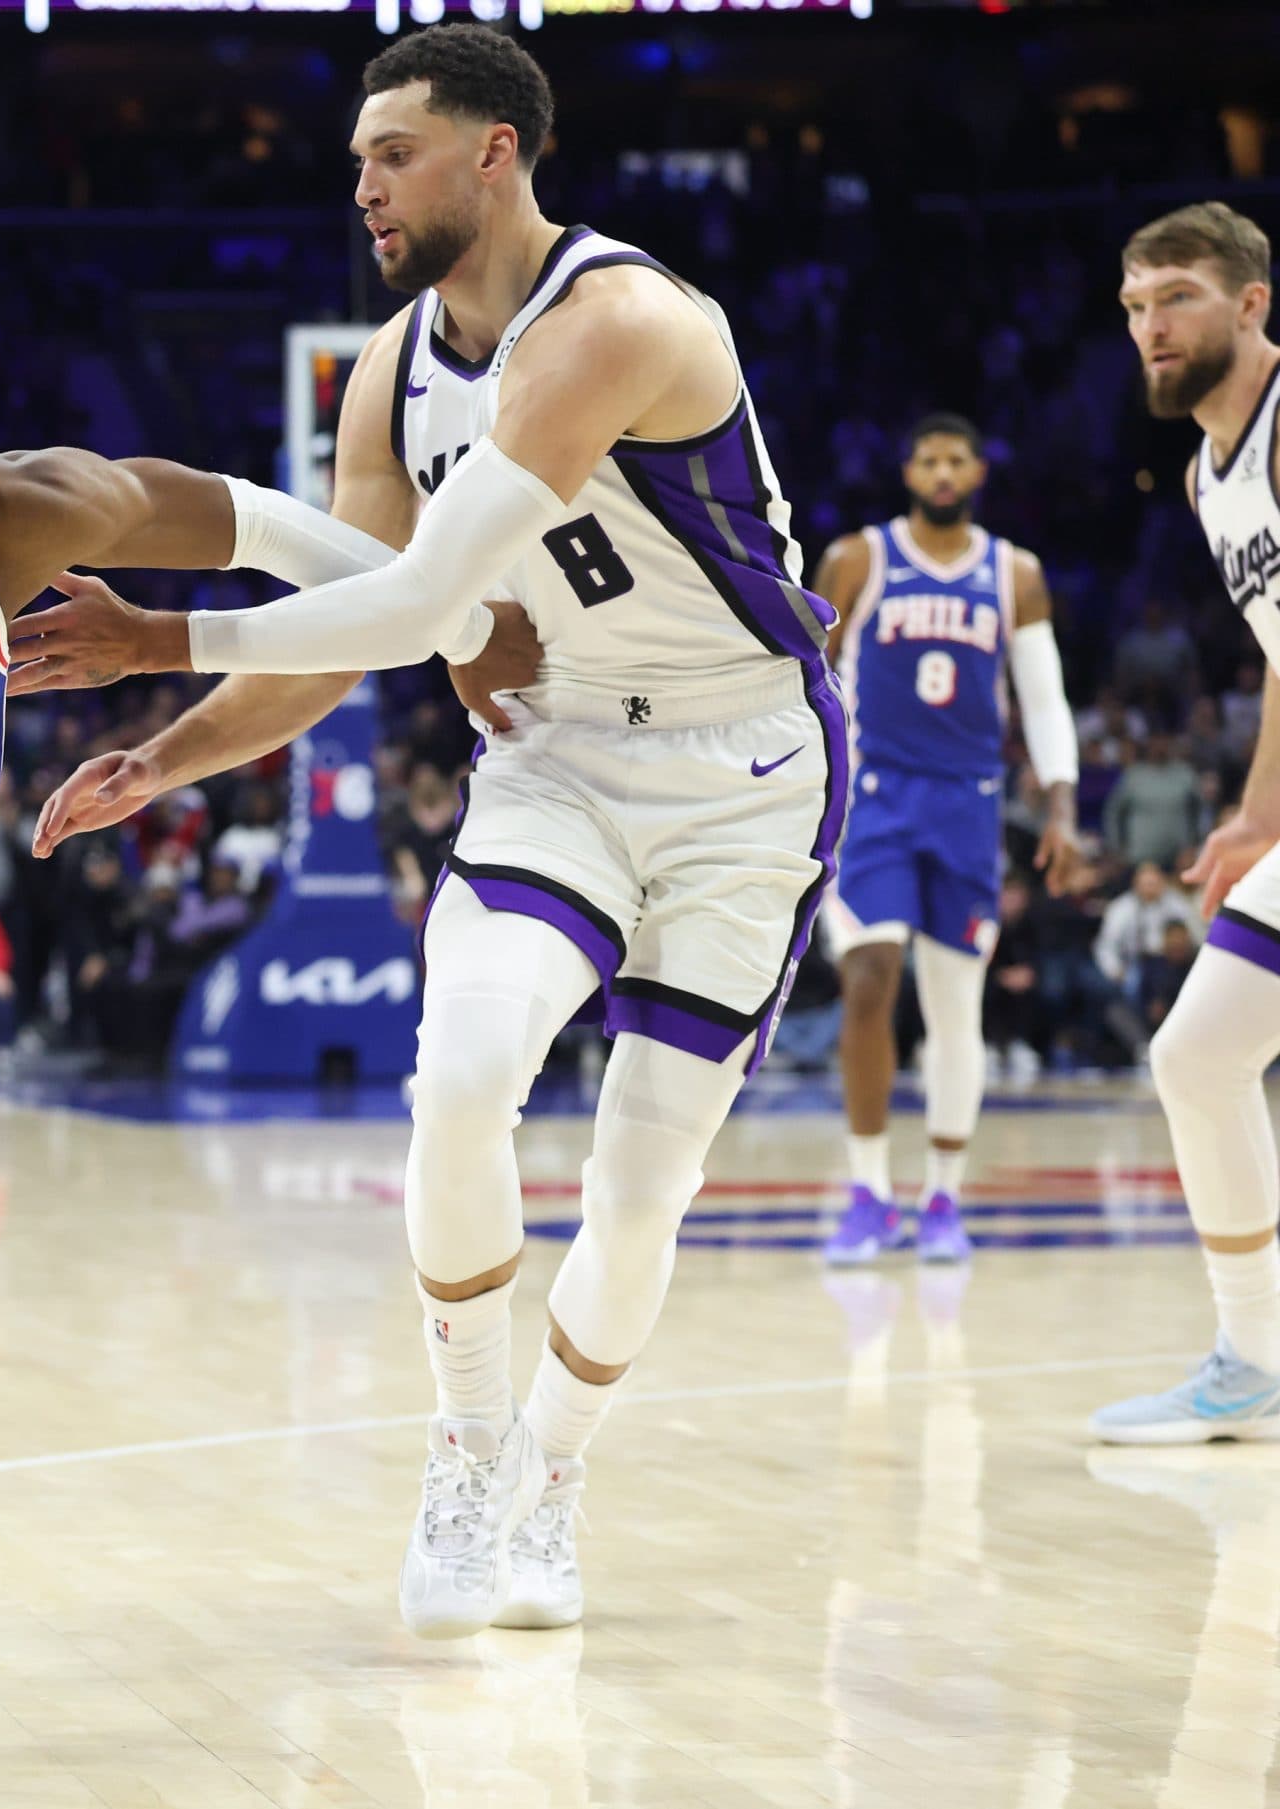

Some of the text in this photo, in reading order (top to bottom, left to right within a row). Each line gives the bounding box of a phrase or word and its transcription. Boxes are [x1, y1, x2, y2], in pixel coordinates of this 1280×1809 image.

[541, 512, 635, 609] 8
[876, 594, 999, 653] PHILA
[916, 650, 957, 706] 8
